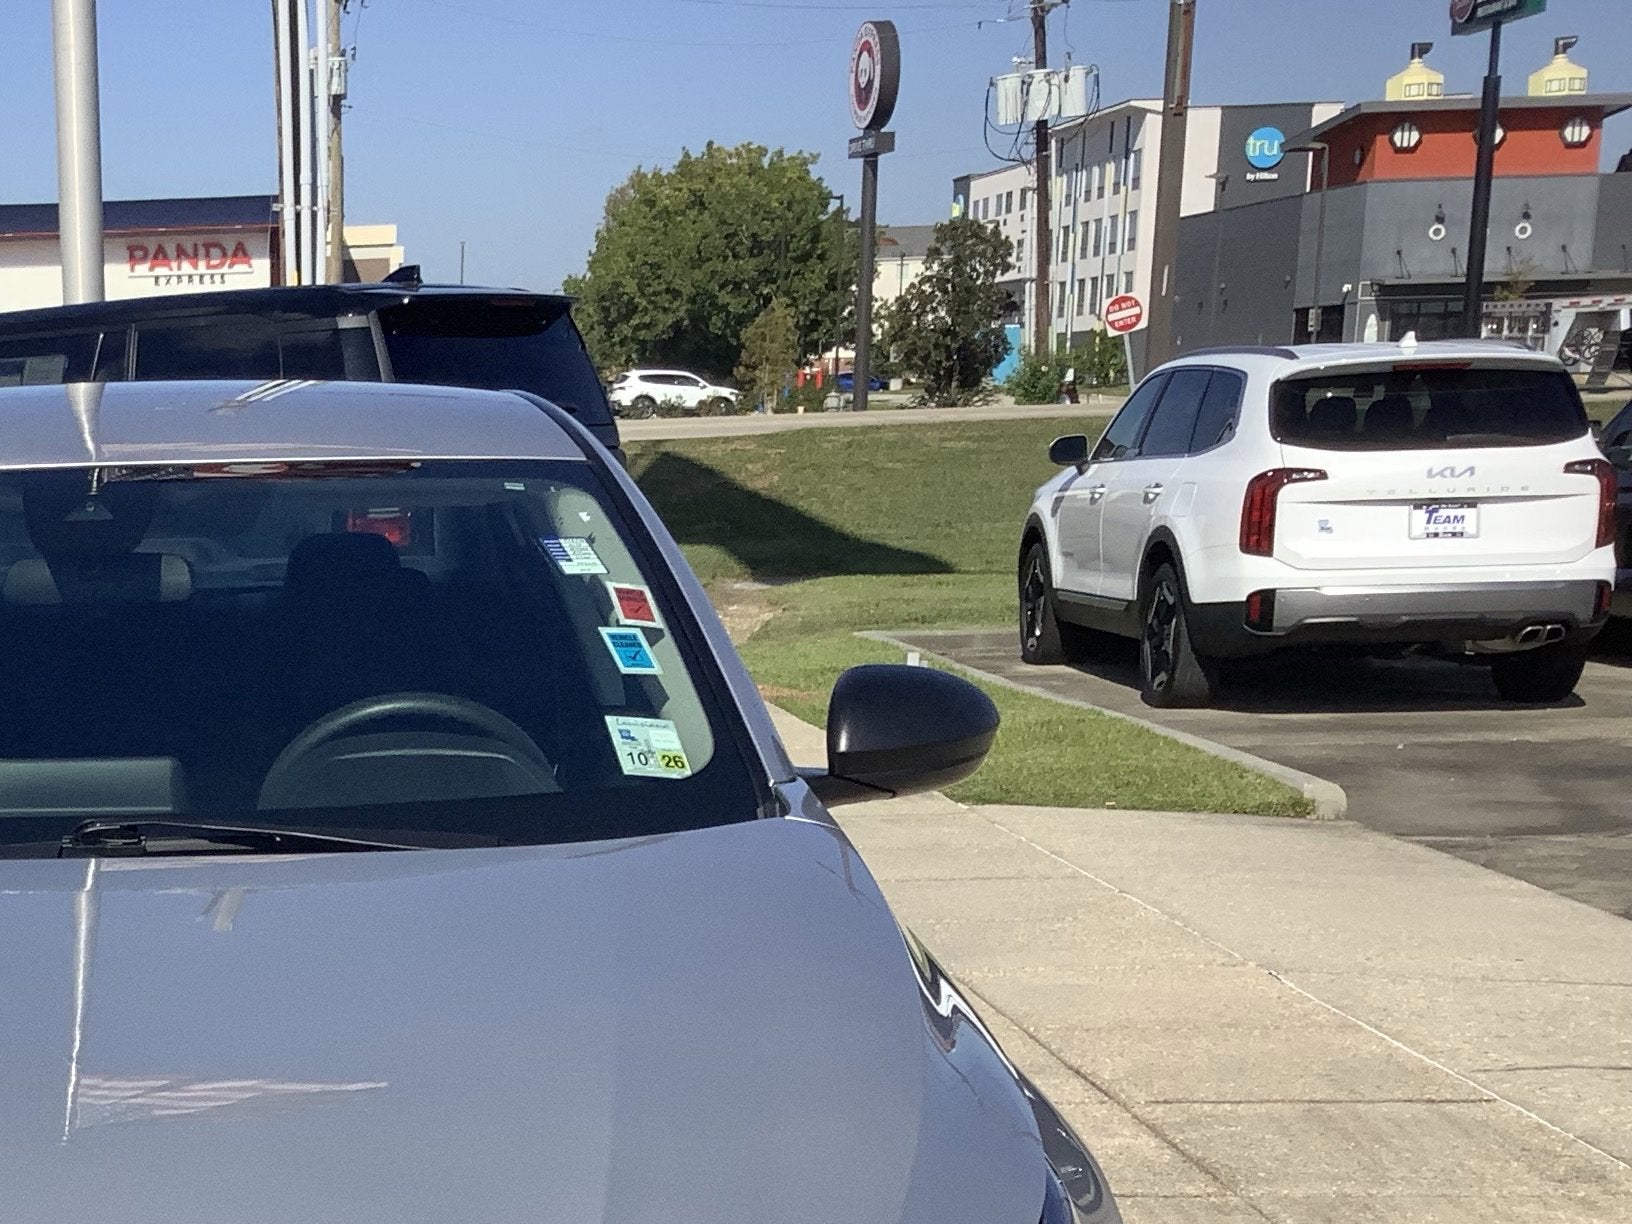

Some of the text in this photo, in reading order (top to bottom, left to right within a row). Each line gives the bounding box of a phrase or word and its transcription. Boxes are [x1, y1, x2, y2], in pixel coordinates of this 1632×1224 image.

[1247, 136, 1279, 157] tru
[126, 240, 253, 273] PANDA
[154, 272, 226, 286] EXPRESS
[1120, 299, 1136, 309] NOT
[1114, 316, 1137, 328] ENTER
[1426, 465, 1475, 479] KIA
[1366, 485, 1530, 496] TELLURIDE
[1424, 505, 1466, 525] TEAM
[626, 751, 649, 767] 10
[661, 754, 686, 769] 26
